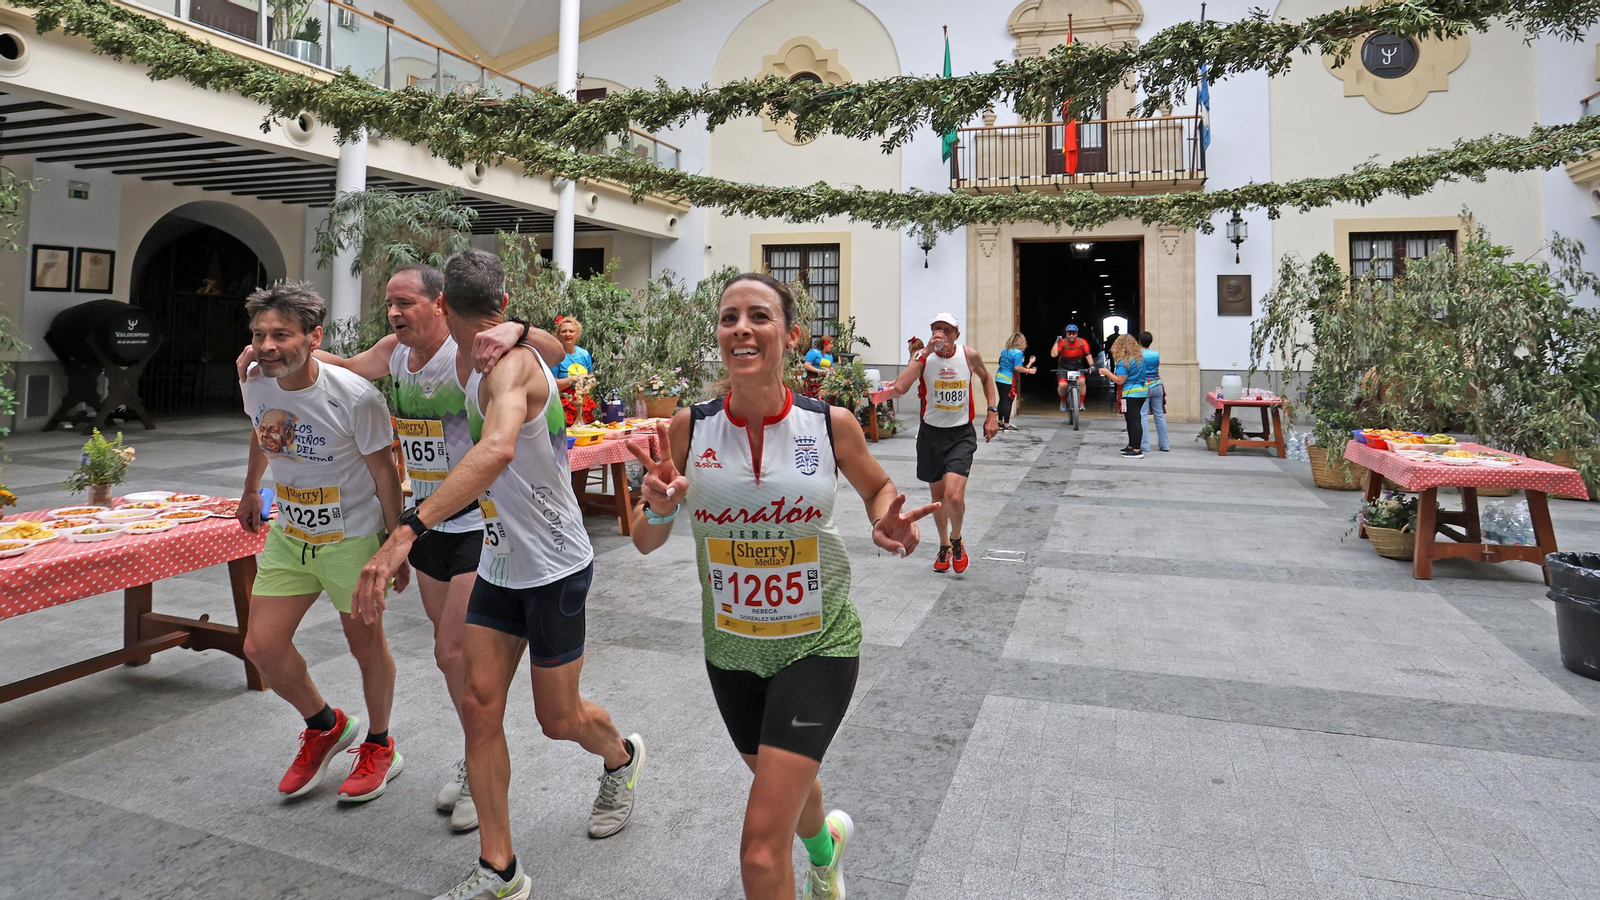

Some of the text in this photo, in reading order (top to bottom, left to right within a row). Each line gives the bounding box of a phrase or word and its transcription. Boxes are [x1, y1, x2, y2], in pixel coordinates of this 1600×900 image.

[939, 390, 963, 402] 1088
[293, 423, 312, 434] LOS
[396, 420, 424, 434] Sherry
[295, 434, 326, 446] NIÑOS
[296, 444, 317, 455] DEL
[402, 439, 435, 463] 165
[289, 488, 320, 503] Sherry
[531, 484, 553, 506] Los
[285, 504, 331, 528] 1225
[694, 495, 823, 525] maratón
[728, 530, 785, 539] JEREZ
[736, 542, 790, 563] Sherry
[754, 558, 781, 567] Media
[727, 570, 805, 608] 1265
[739, 614, 769, 622] GONZALEZ
[769, 614, 793, 622] MARTIN
